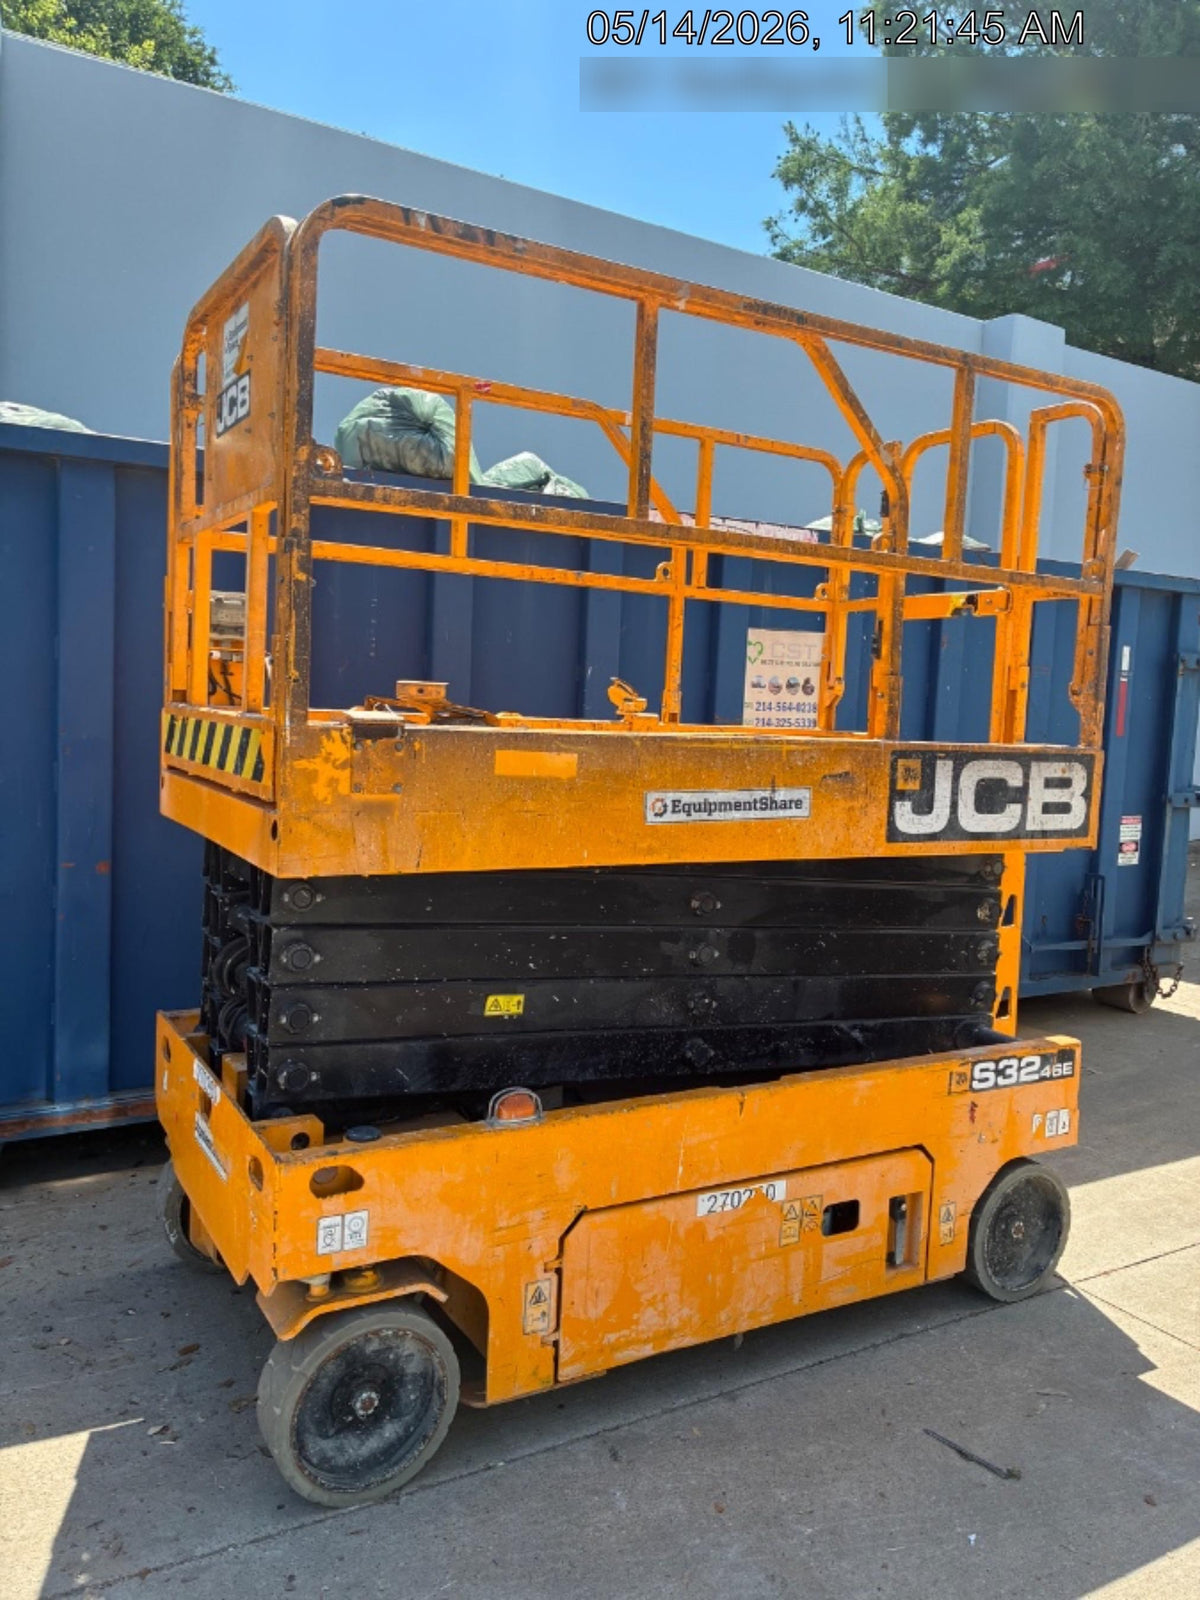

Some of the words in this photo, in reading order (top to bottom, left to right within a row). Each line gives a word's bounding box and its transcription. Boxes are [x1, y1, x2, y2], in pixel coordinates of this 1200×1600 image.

[217, 374, 250, 433] JCB
[670, 797, 803, 817] EquipmentShare
[894, 760, 1088, 834] JCB
